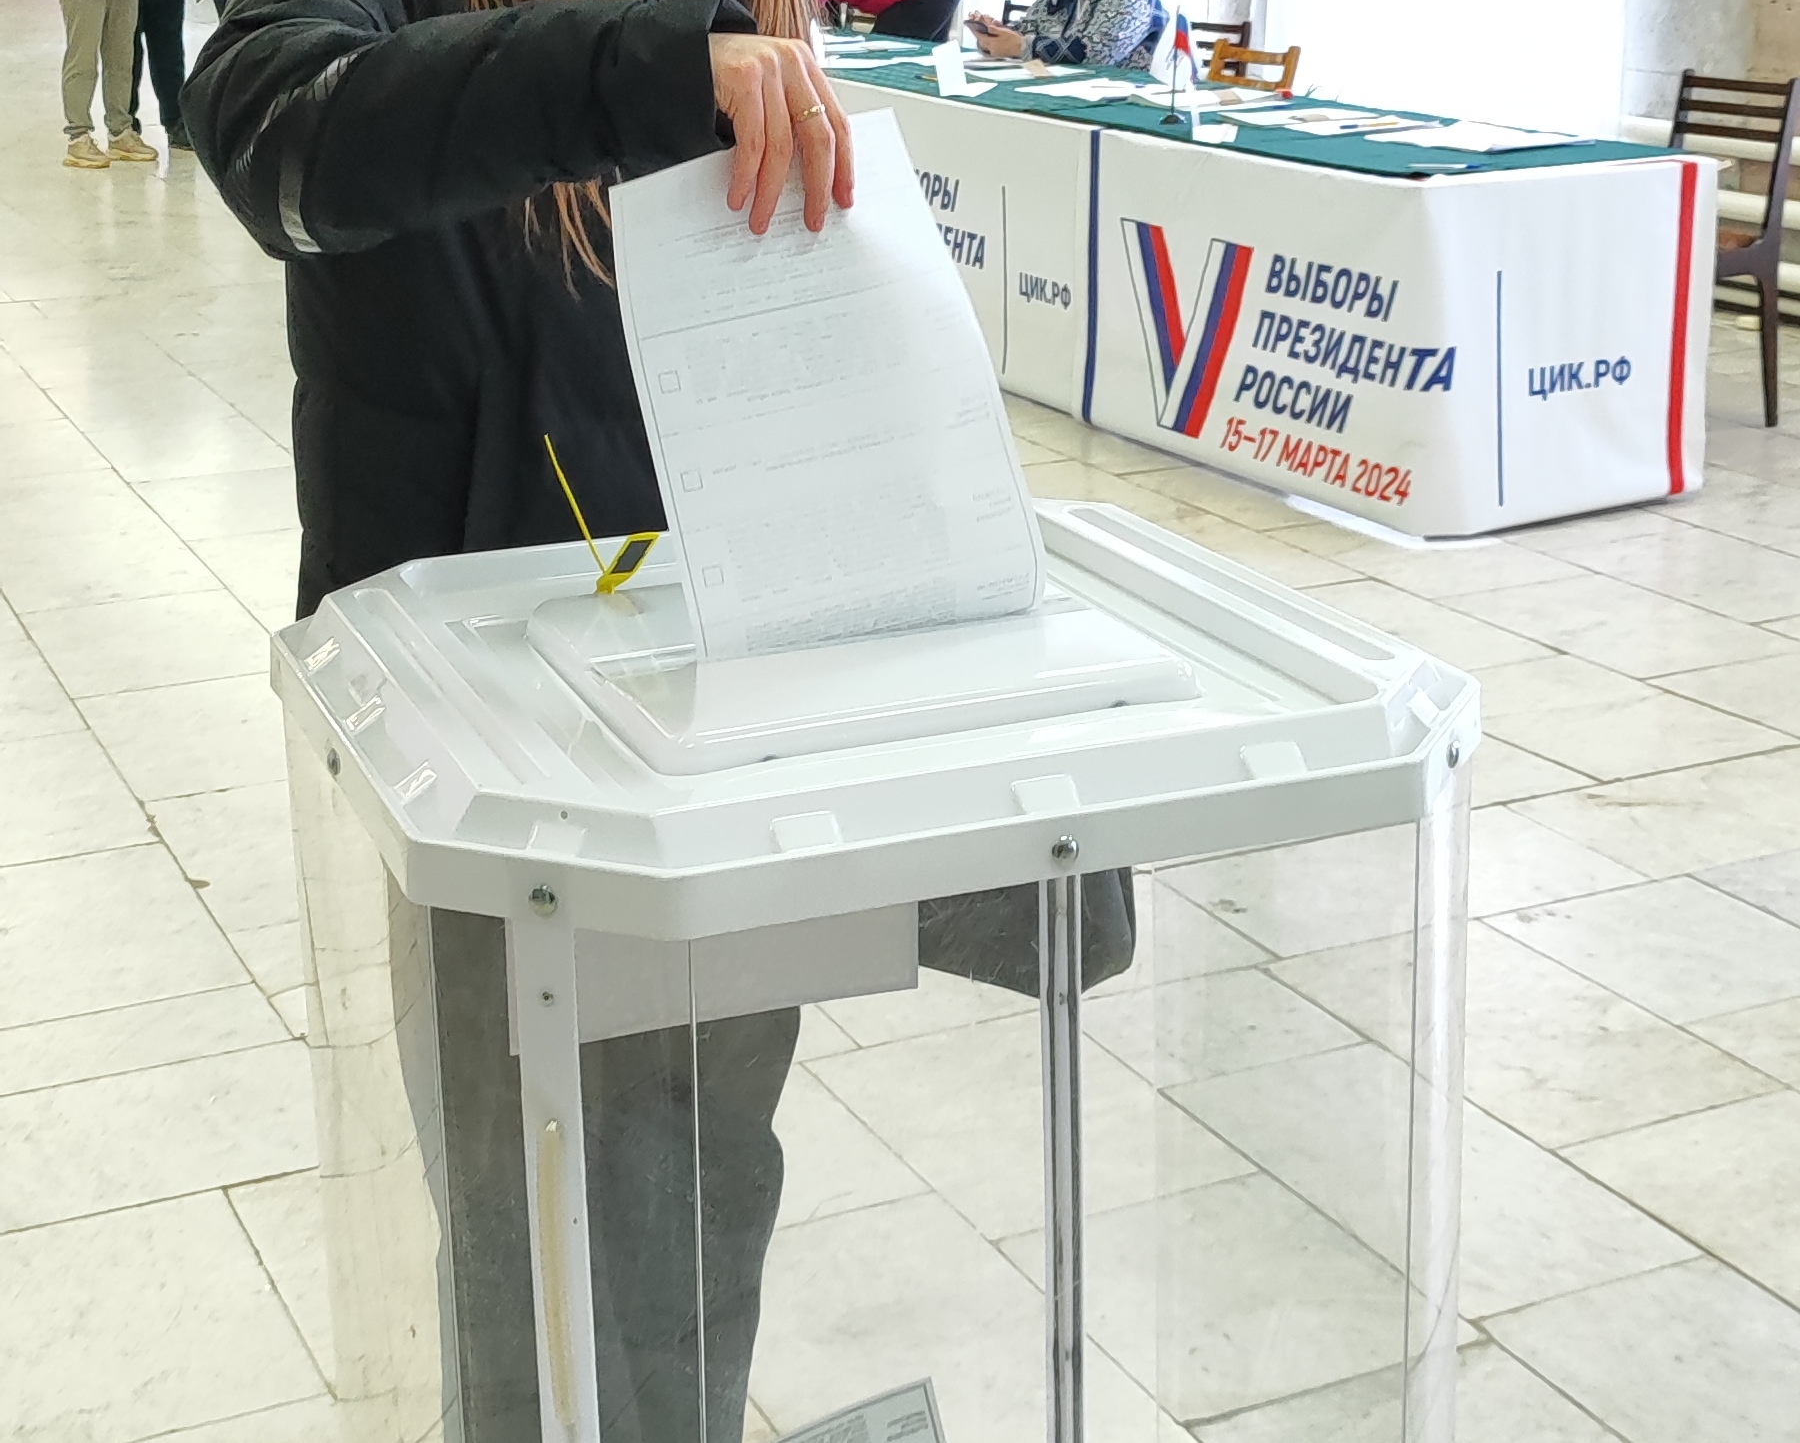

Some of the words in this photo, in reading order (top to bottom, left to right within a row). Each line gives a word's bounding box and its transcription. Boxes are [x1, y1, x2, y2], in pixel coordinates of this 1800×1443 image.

[914, 168, 960, 213] ОРЫ
[1019, 271, 1072, 310] ЦИК.РФ
[1265, 253, 1400, 322] ВЫБОРЫ
[1252, 309, 1457, 393] ПРЕЗИДЕНТА
[1528, 355, 1632, 402] ЦИК.РФ
[1233, 364, 1354, 434] РОССИИ
[1276, 433, 1352, 489] МАРТА
[1351, 458, 1412, 506] 2024
